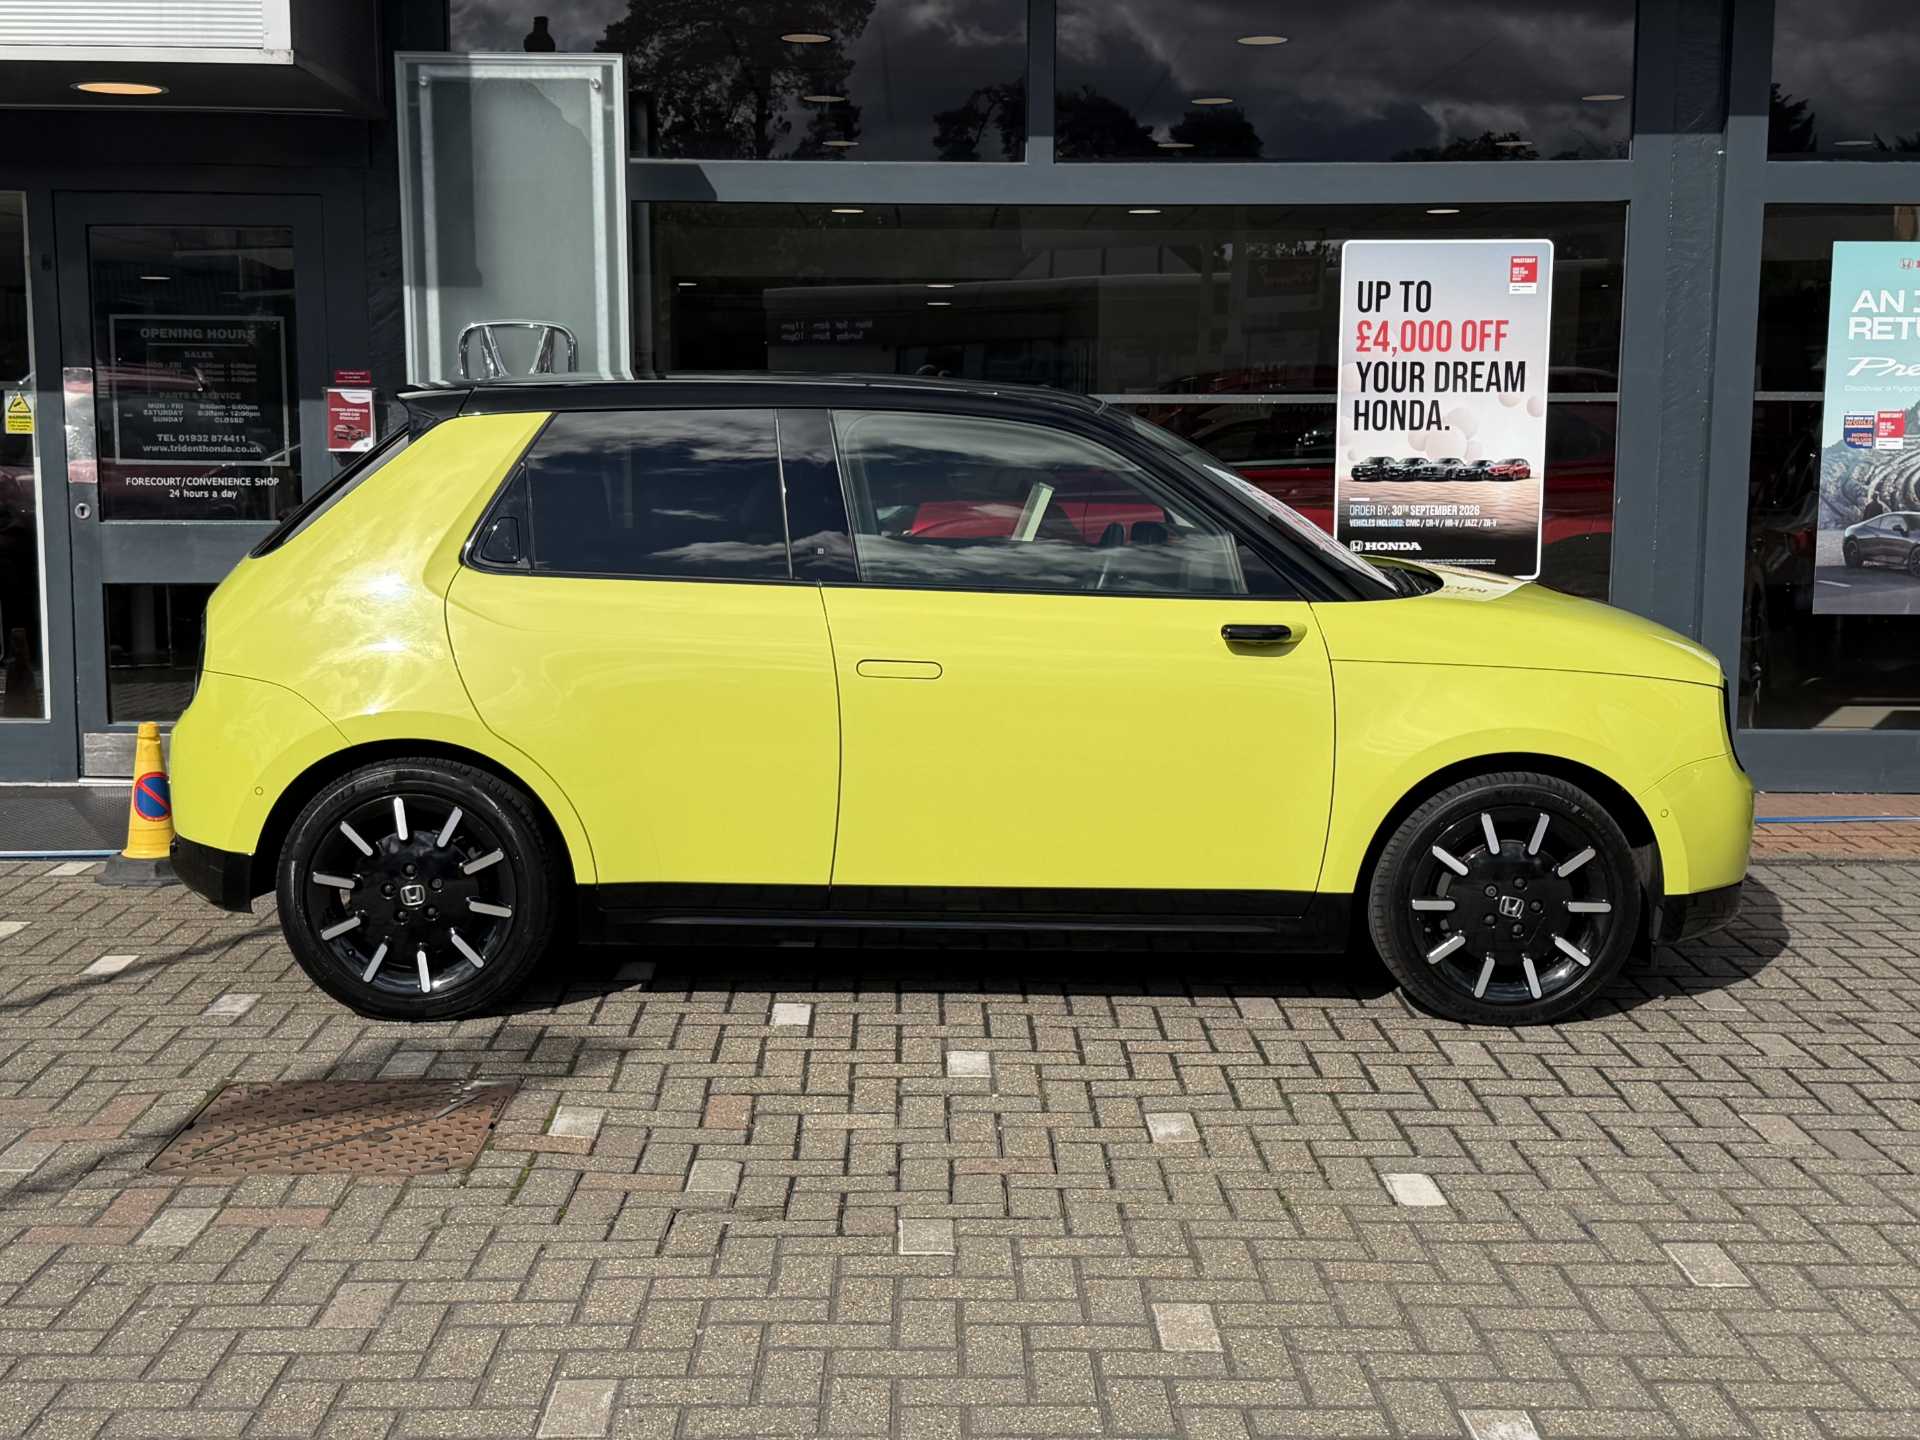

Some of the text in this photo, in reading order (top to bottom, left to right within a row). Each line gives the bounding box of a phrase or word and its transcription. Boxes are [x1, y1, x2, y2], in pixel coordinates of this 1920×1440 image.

[1357, 281, 1432, 313] UP TO
[1852, 289, 1905, 313] AN
[140, 327, 257, 340] OPENING HOURS
[1356, 320, 1509, 357] £4,000 OFF
[1356, 361, 1526, 393] YOUR DREAM
[1353, 400, 1450, 431] HONDA.
[157, 434, 246, 443] TEL 01932 874411
[125, 476, 280, 488] FORECOURT/CONVENIENCE SHOP
[168, 489, 180, 498] 24
[183, 489, 209, 498] hours
[221, 489, 238, 500] day
[1349, 504, 1376, 516] ORDER
[1377, 505, 1390, 516] BY:
[1410, 504, 1458, 516] SEPTEMBER
[1349, 518, 1375, 527] VEHICLES
[1364, 541, 1422, 551] HONDA
